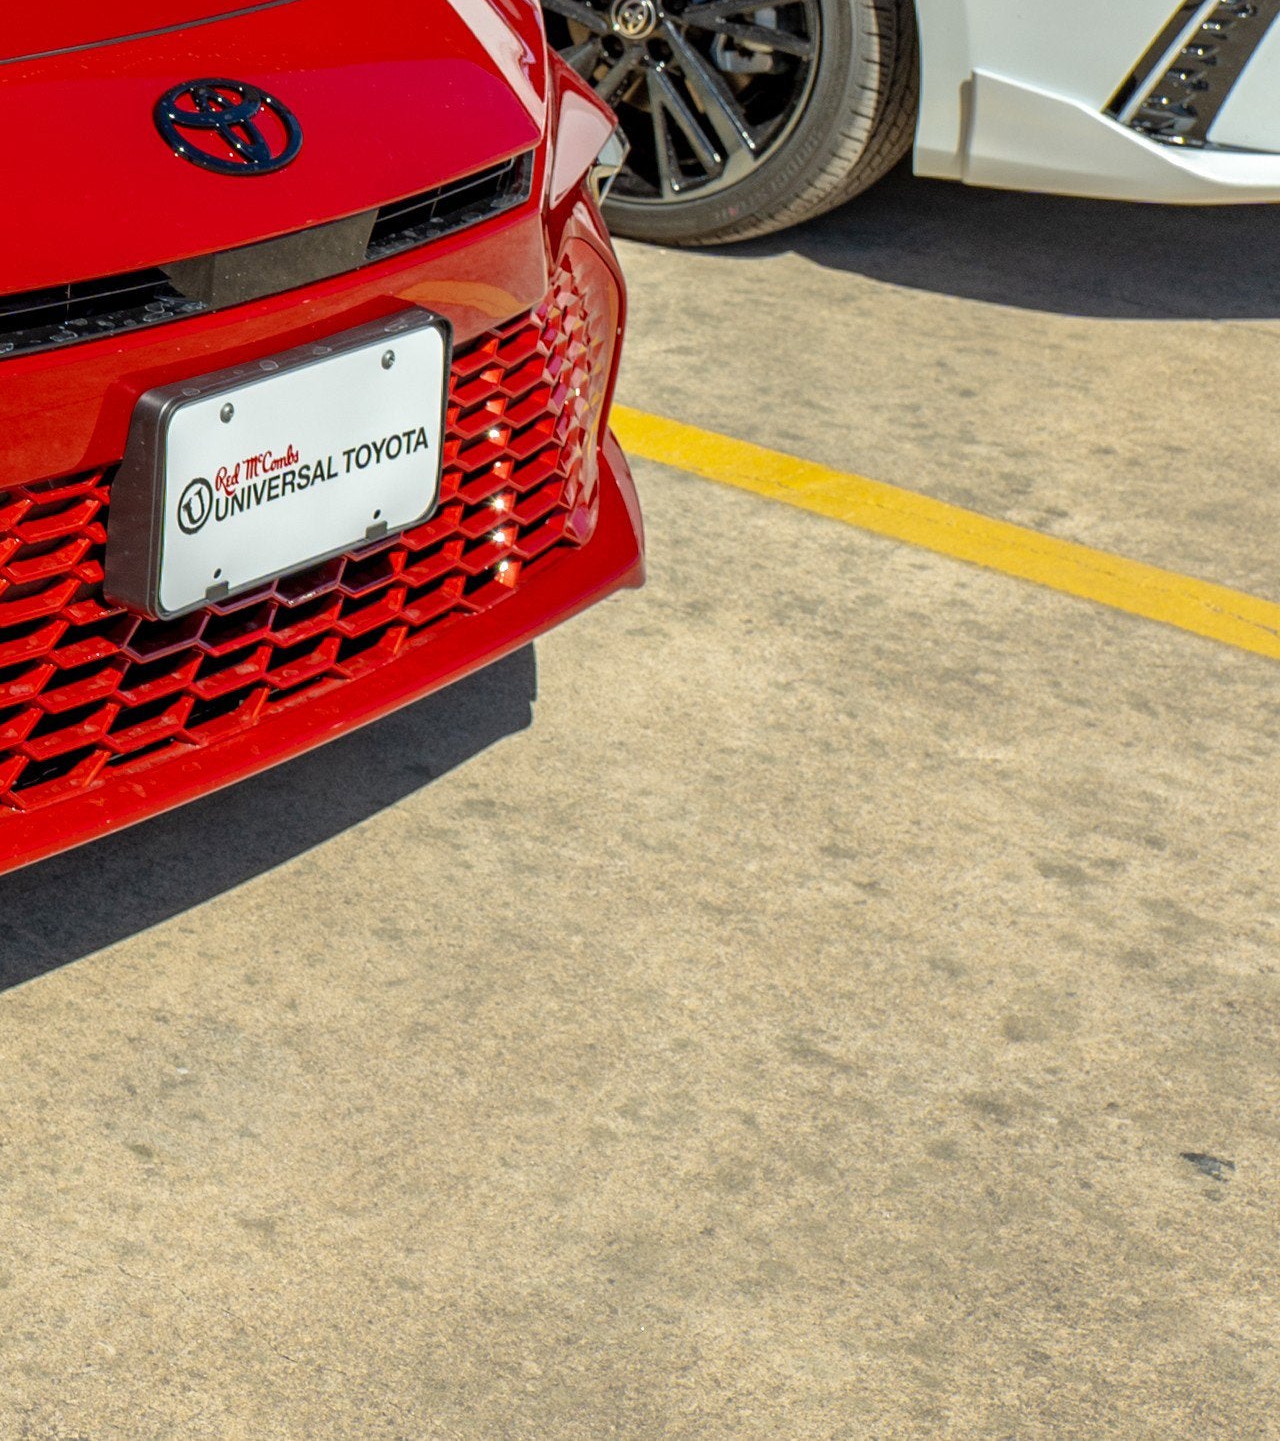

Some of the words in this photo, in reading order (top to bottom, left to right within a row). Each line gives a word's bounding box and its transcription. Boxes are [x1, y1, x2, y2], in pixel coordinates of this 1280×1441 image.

[215, 462, 241, 496] Red
[242, 443, 300, 481] McCombs
[215, 455, 339, 522] UNIVERSAL
[342, 426, 429, 474] TOYOTA
